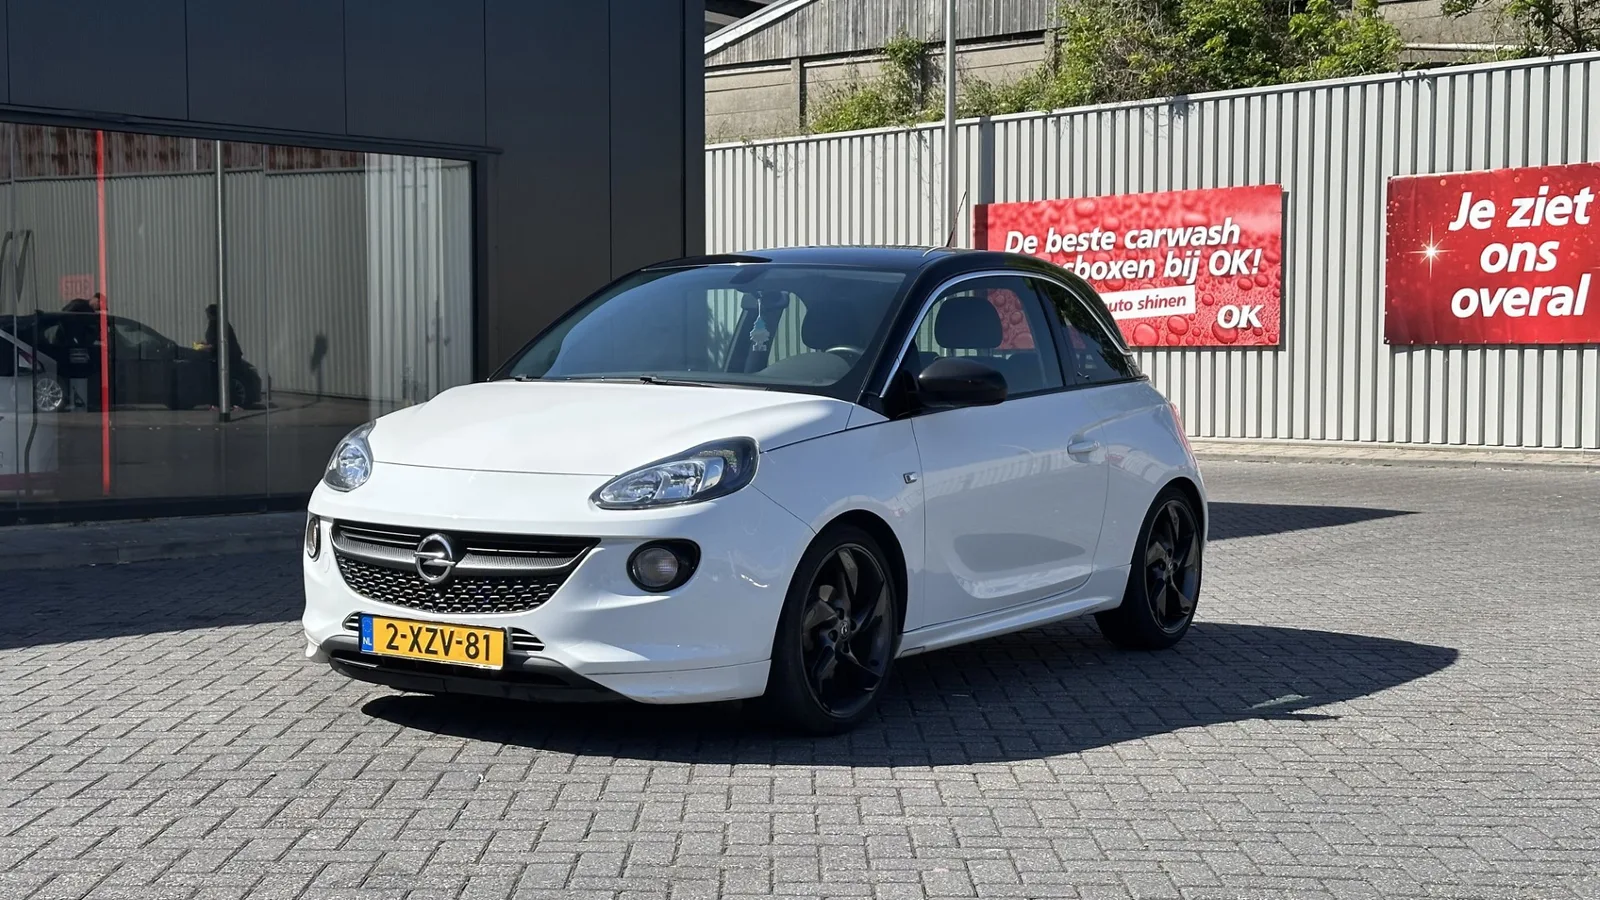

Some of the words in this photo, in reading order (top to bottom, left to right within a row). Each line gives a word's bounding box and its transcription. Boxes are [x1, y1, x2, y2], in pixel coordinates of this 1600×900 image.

[1447, 192, 1496, 231] Je
[1506, 185, 1595, 228] ziet
[1004, 231, 1036, 254] De
[1045, 226, 1116, 253] beste
[1124, 217, 1240, 249] carwash
[1164, 254, 1200, 285] bij
[1209, 248, 1262, 277] OK!
[1479, 240, 1560, 274] ons
[1104, 298, 1133, 312] uto
[1137, 294, 1186, 311] shinen
[1451, 273, 1592, 319] overal
[1217, 304, 1263, 329] OK
[362, 637, 372, 646] NL
[386, 623, 490, 661] 2-XZV-81
